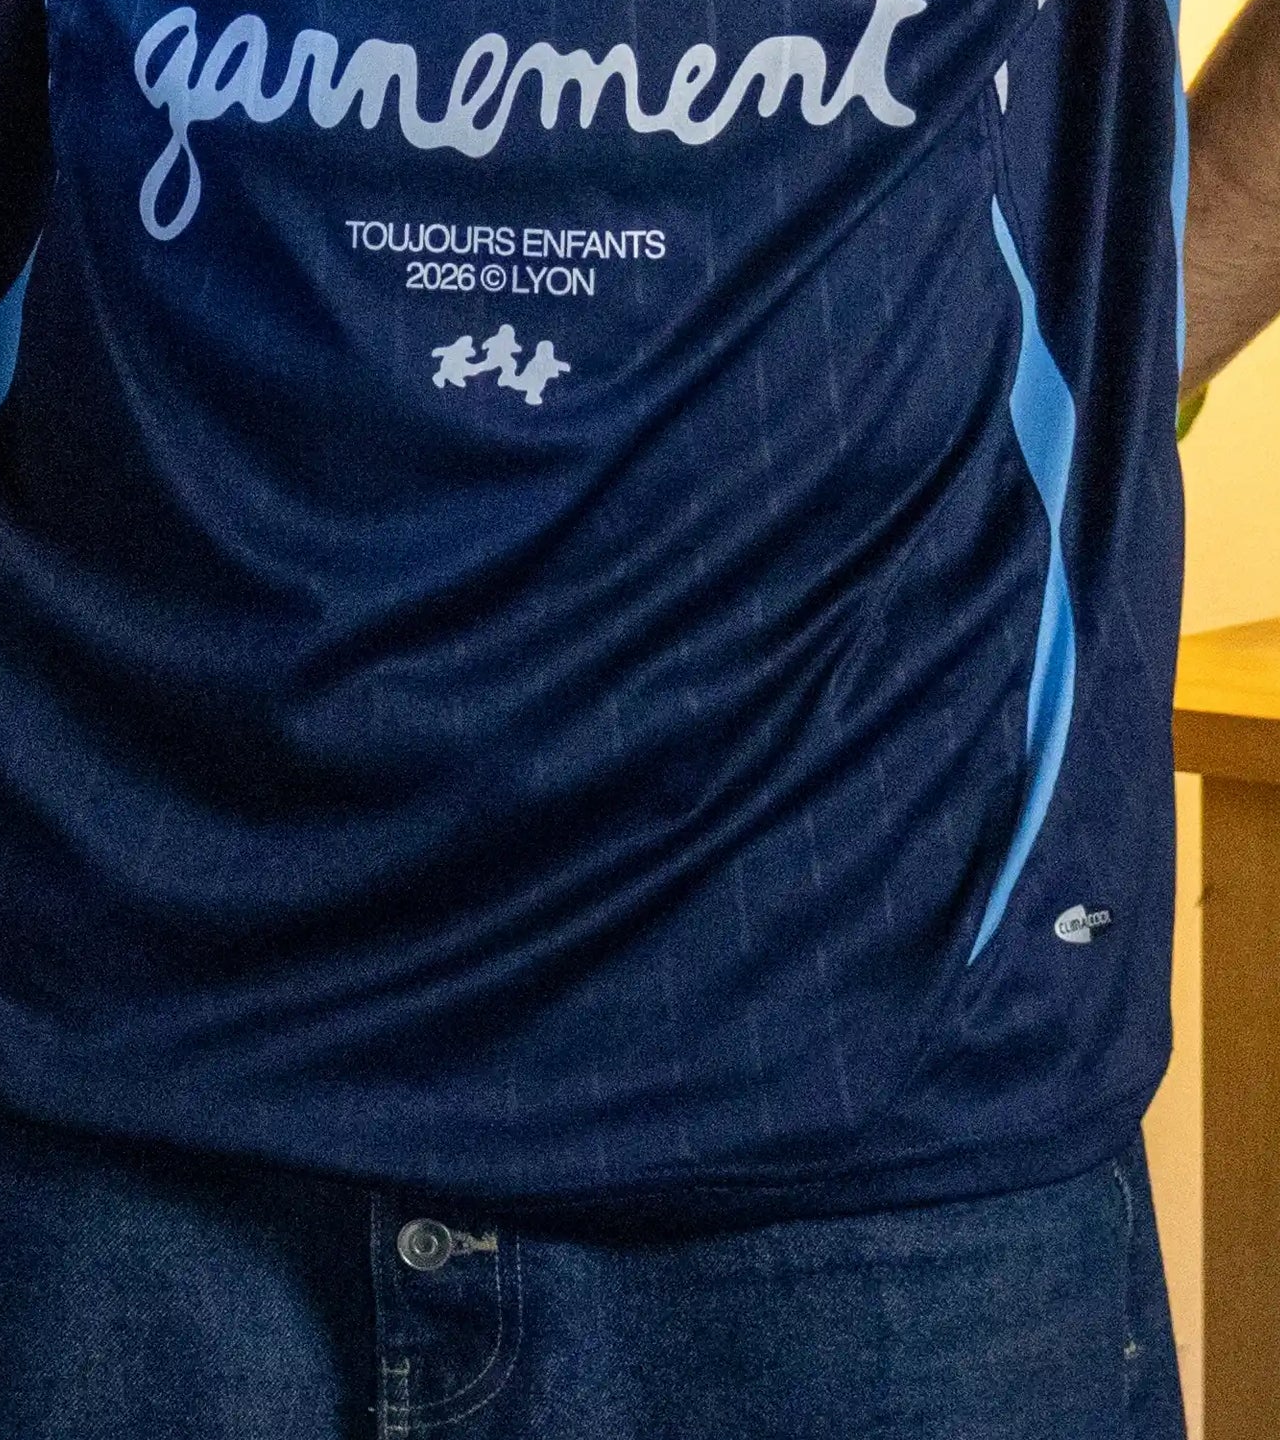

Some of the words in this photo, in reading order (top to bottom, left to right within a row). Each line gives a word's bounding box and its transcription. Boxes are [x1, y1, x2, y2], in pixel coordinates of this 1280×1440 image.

[345, 219, 516, 257] TOUJOURS
[522, 227, 667, 260] ENFANTS
[405, 261, 476, 292] 2026
[511, 264, 596, 297] LYON
